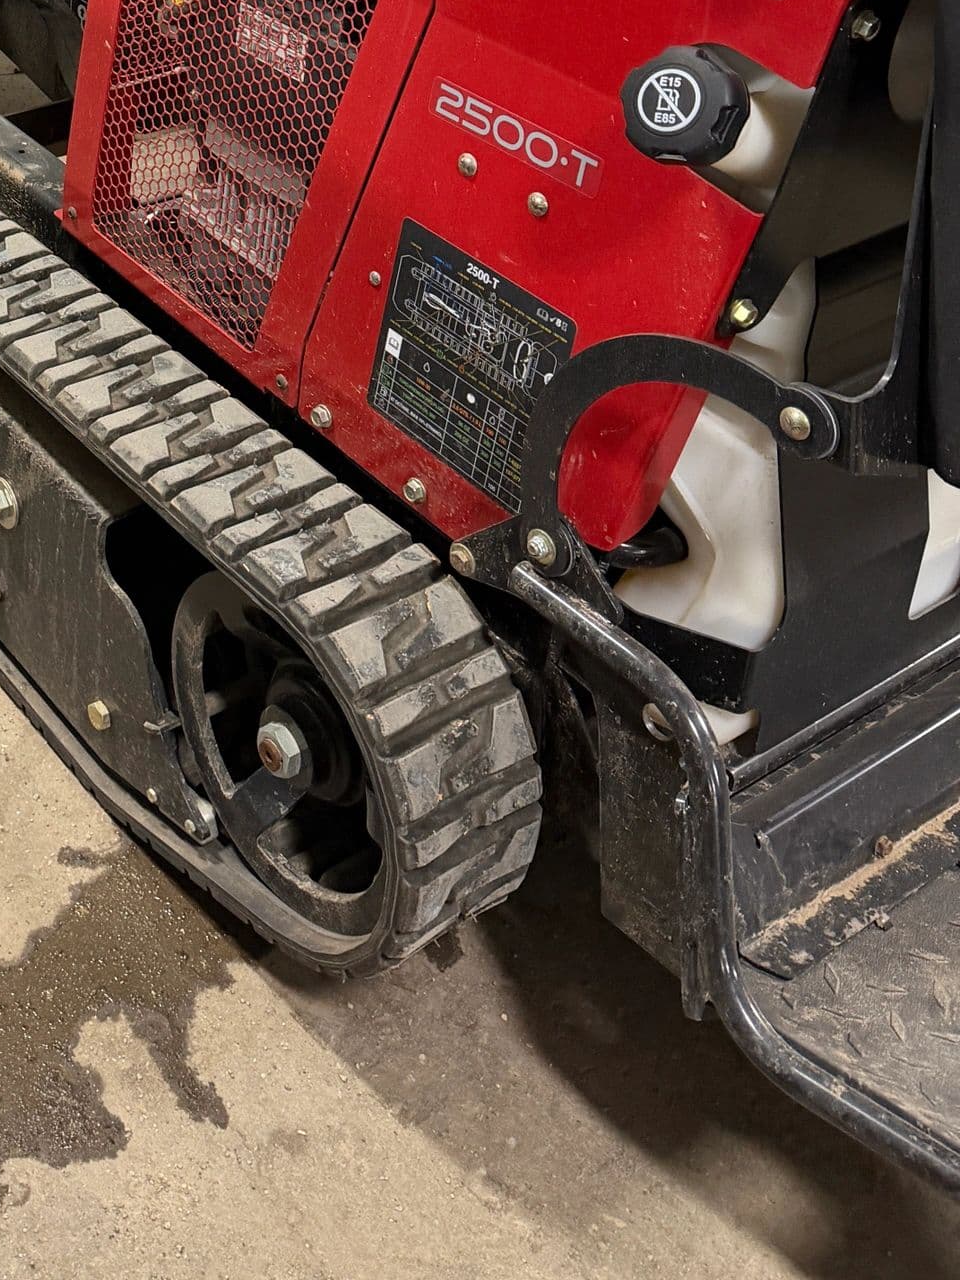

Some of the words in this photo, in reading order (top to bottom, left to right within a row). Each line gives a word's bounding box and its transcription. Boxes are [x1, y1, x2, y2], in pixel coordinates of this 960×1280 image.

[659, 76, 682, 88] E15
[654, 112, 676, 124] E85
[466, 262, 500, 290] 2500-T
